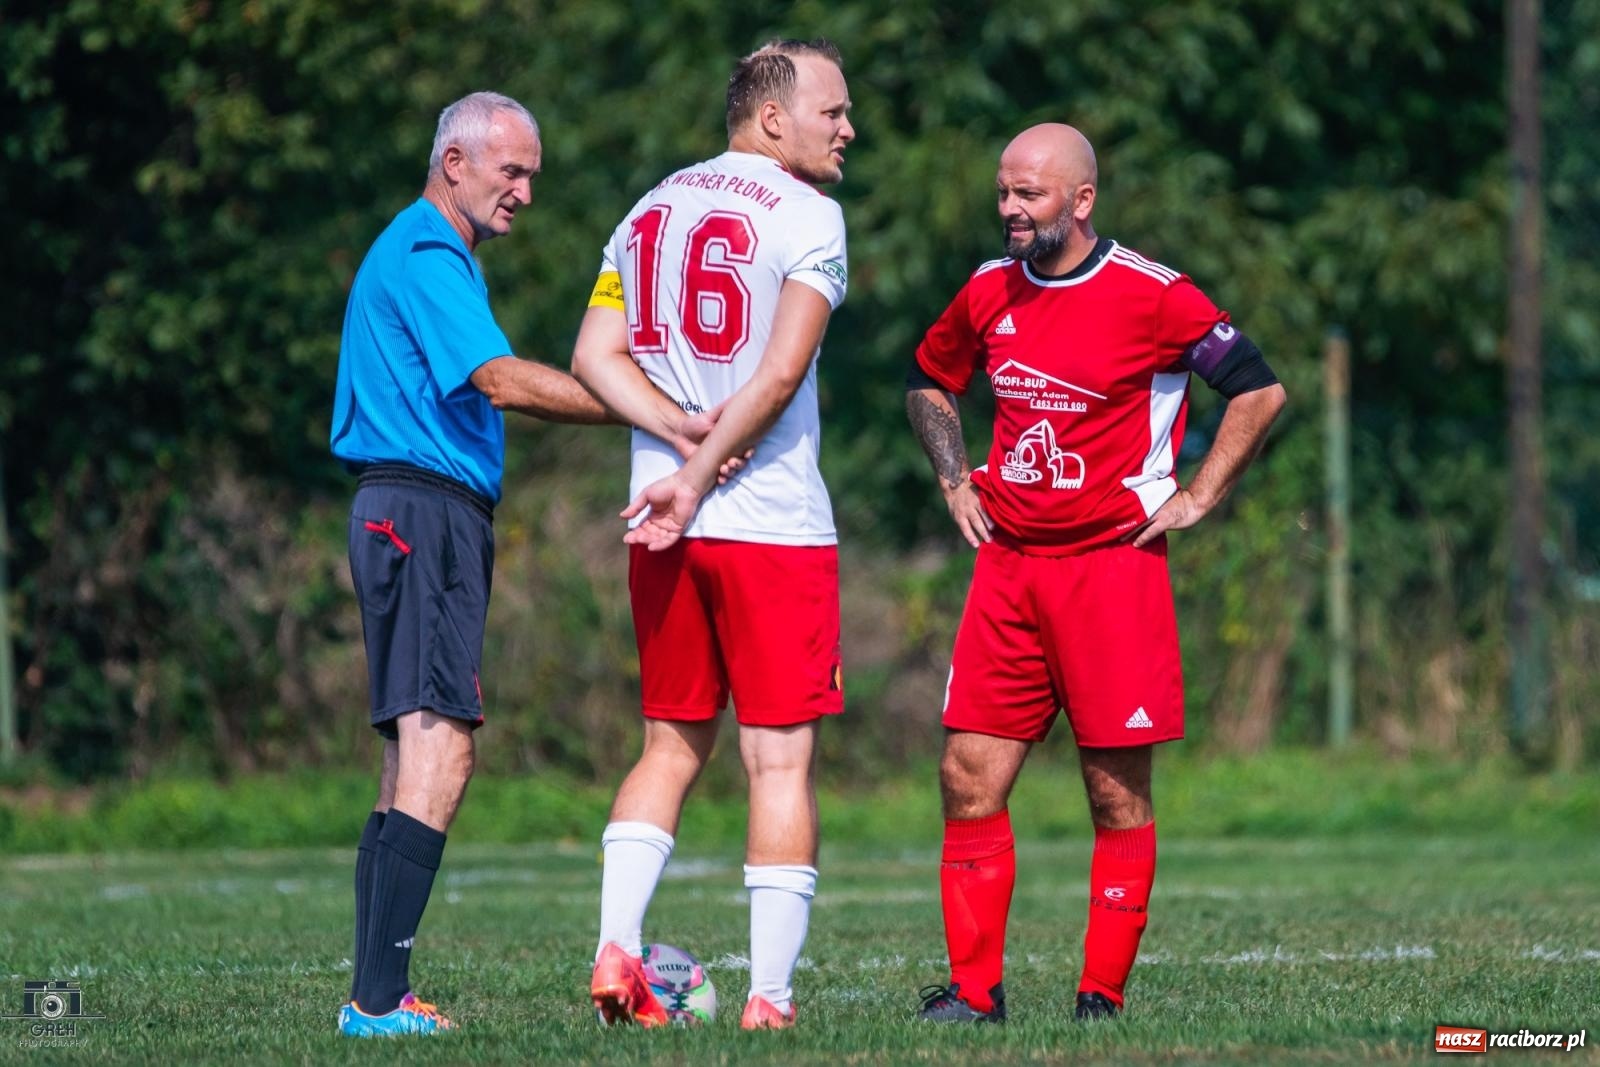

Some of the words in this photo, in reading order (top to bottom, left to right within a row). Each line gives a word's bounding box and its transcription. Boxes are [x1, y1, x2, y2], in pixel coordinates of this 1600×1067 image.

[672, 172, 726, 191] WICHER
[723, 176, 782, 211] PŁONIA
[626, 203, 759, 365] 16
[1212, 321, 1236, 342] C
[994, 375, 1047, 389] PROFI-BUD
[1041, 391, 1070, 400] Adam
